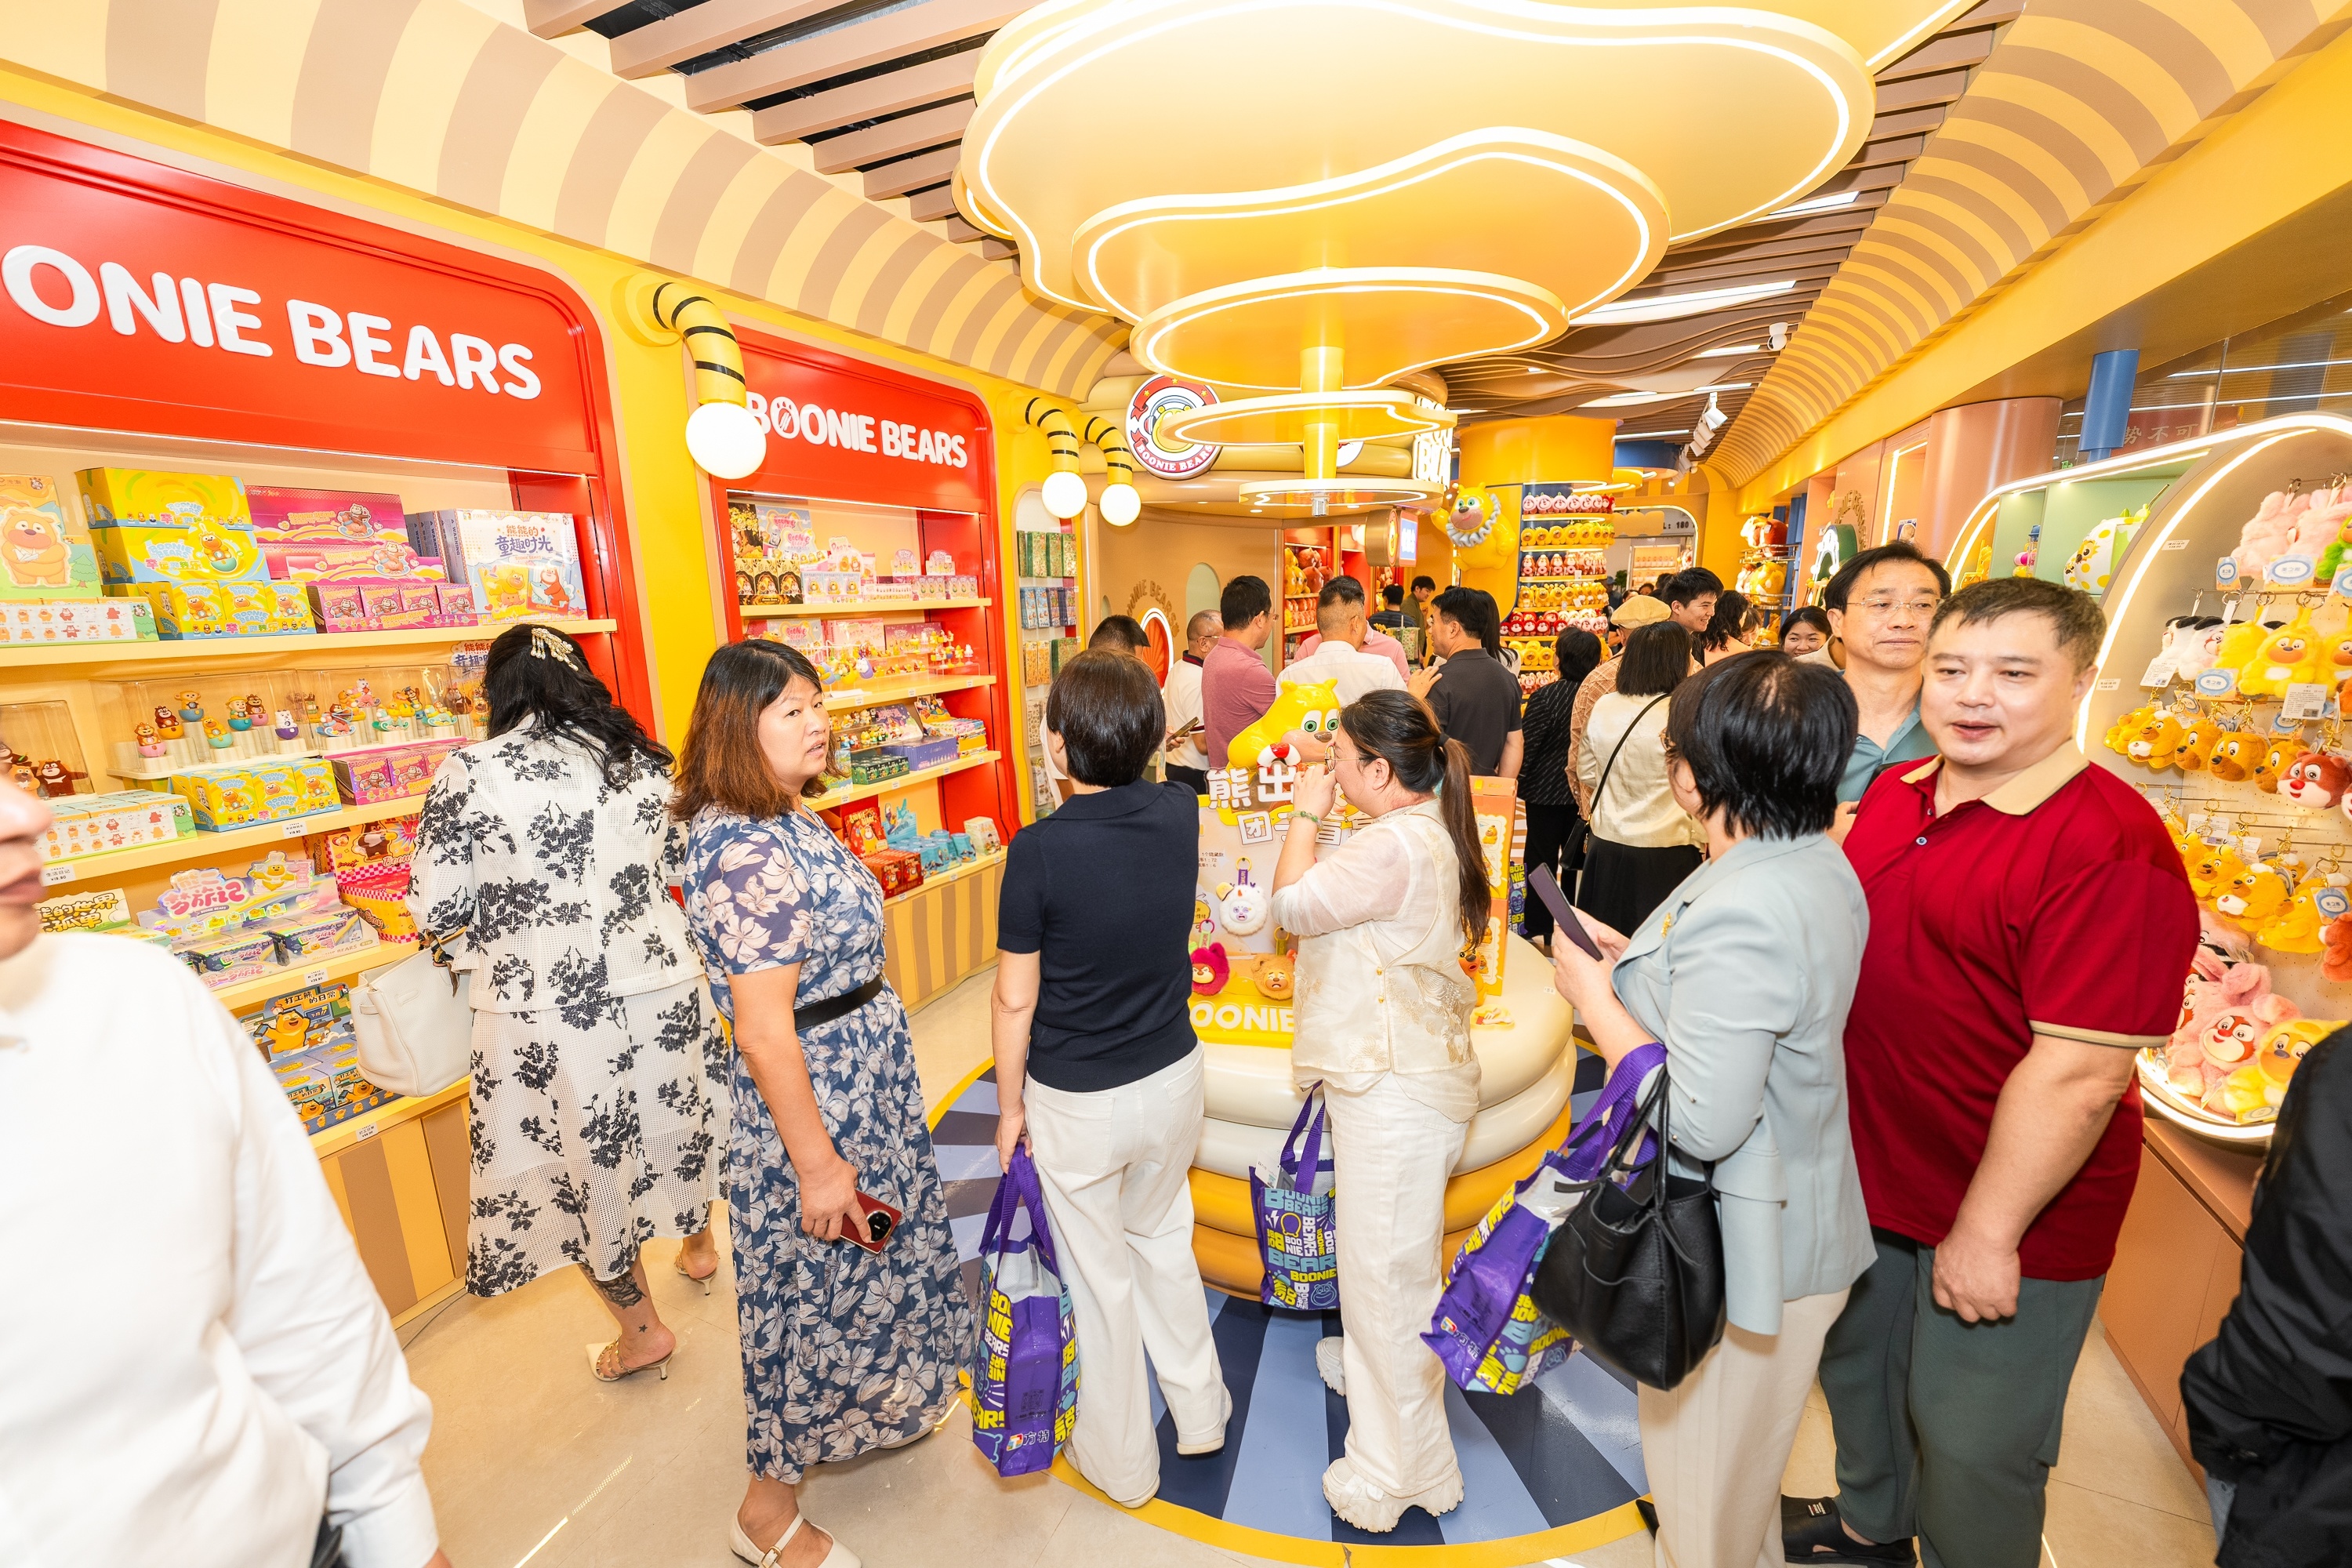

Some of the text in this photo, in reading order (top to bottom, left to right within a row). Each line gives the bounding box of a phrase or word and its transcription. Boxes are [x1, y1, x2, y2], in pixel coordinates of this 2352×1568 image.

[2, 245, 541, 400] ONIE BEARS
[746, 391, 967, 468] BOONIE BEARS
[1137, 443, 1214, 471] BOONIE BEARS
[506, 524, 539, 537] 熊熊的
[147, 543, 194, 554] BOONIE
[495, 535, 554, 557] 童趣时光
[157, 550, 189, 559] BEARS
[1150, 580, 1176, 626] BEARS
[233, 610, 269, 619] BOONIE
[265, 794, 298, 806] BOONIE
[272, 801, 295, 810] BEARS
[165, 881, 246, 916] 梦旅记
[337, 944, 358, 953] BEARS
[285, 990, 312, 1004] 打工熊
[309, 991, 336, 1004] 的日常
[1284, 1236, 1302, 1246] BOO
[1302, 1216, 1317, 1257] BEARS
[1286, 1243, 1303, 1256] NIE
[1269, 1247, 1336, 1272] BEAR
[1290, 1269, 1338, 1283] BOONIE
[986, 1311, 1014, 1343] NIE
[984, 1327, 1010, 1358] BEARS
[1023, 1429, 1050, 1446] 方特
